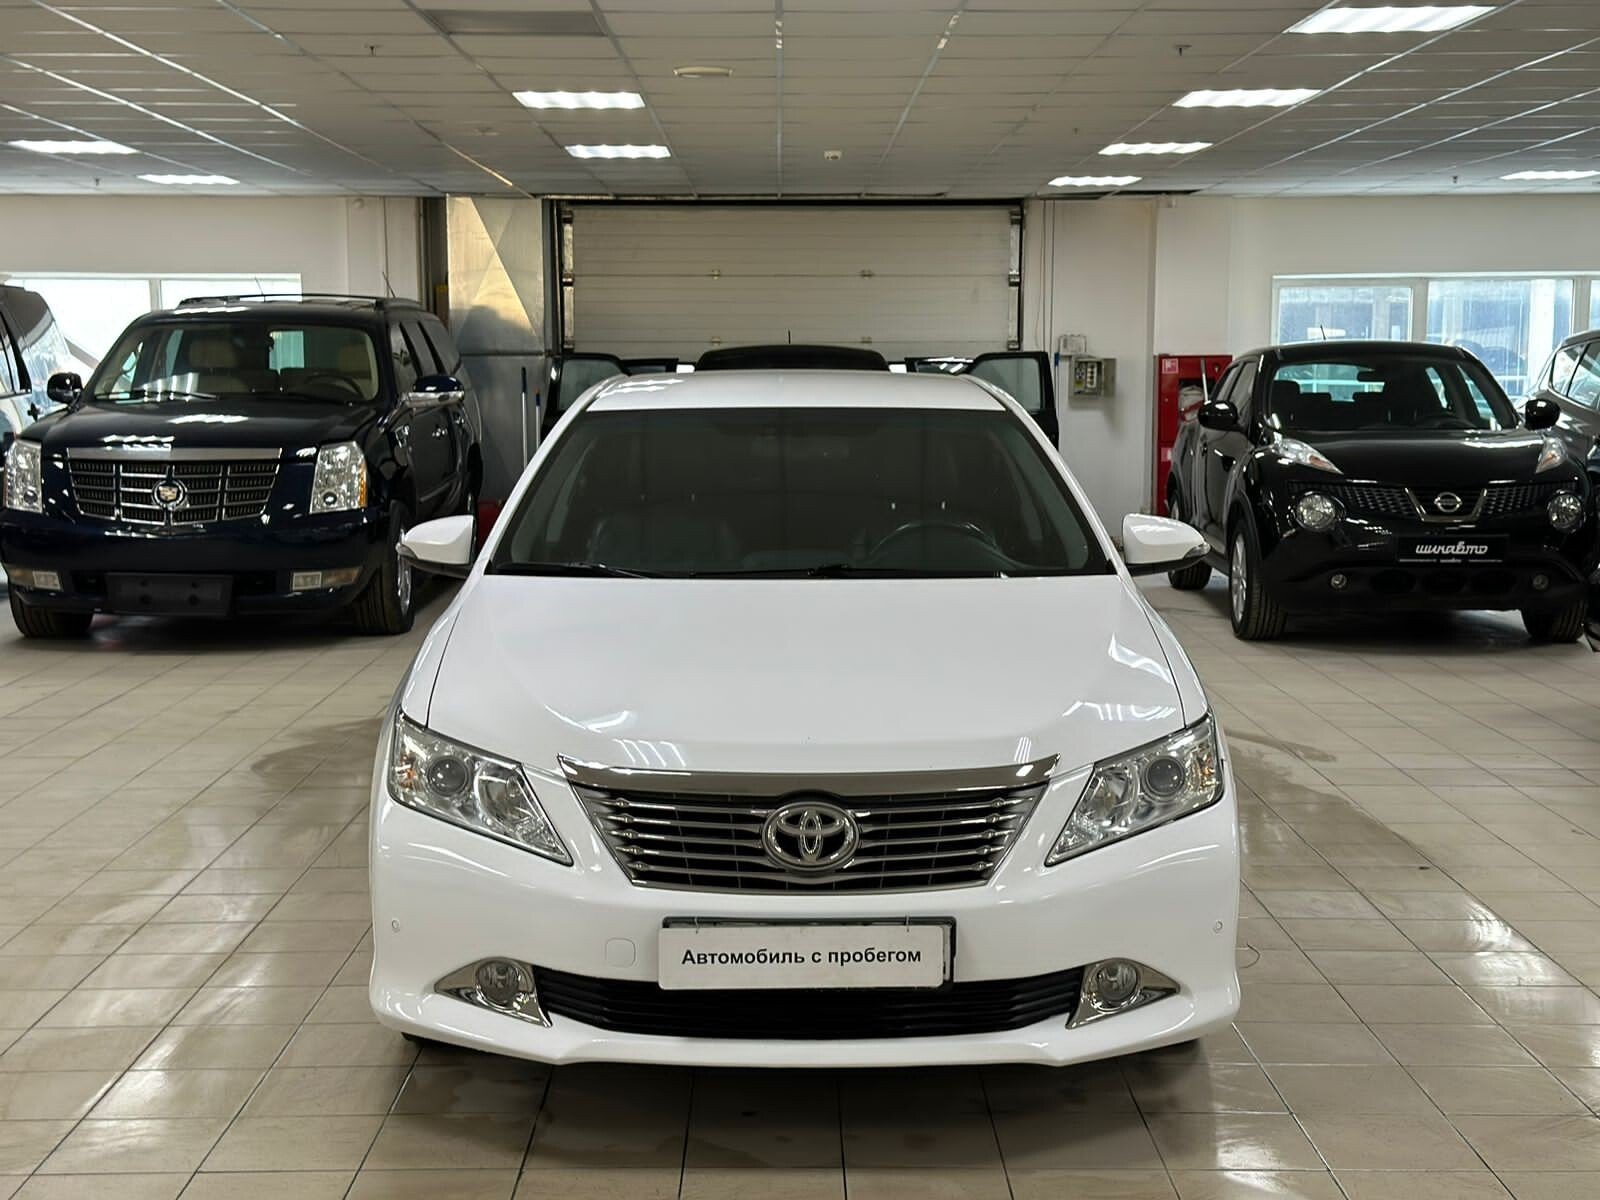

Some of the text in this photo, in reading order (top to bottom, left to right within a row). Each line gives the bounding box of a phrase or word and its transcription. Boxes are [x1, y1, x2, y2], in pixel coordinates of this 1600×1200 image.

[682, 947, 921, 967] Автомобиль с пробегом
